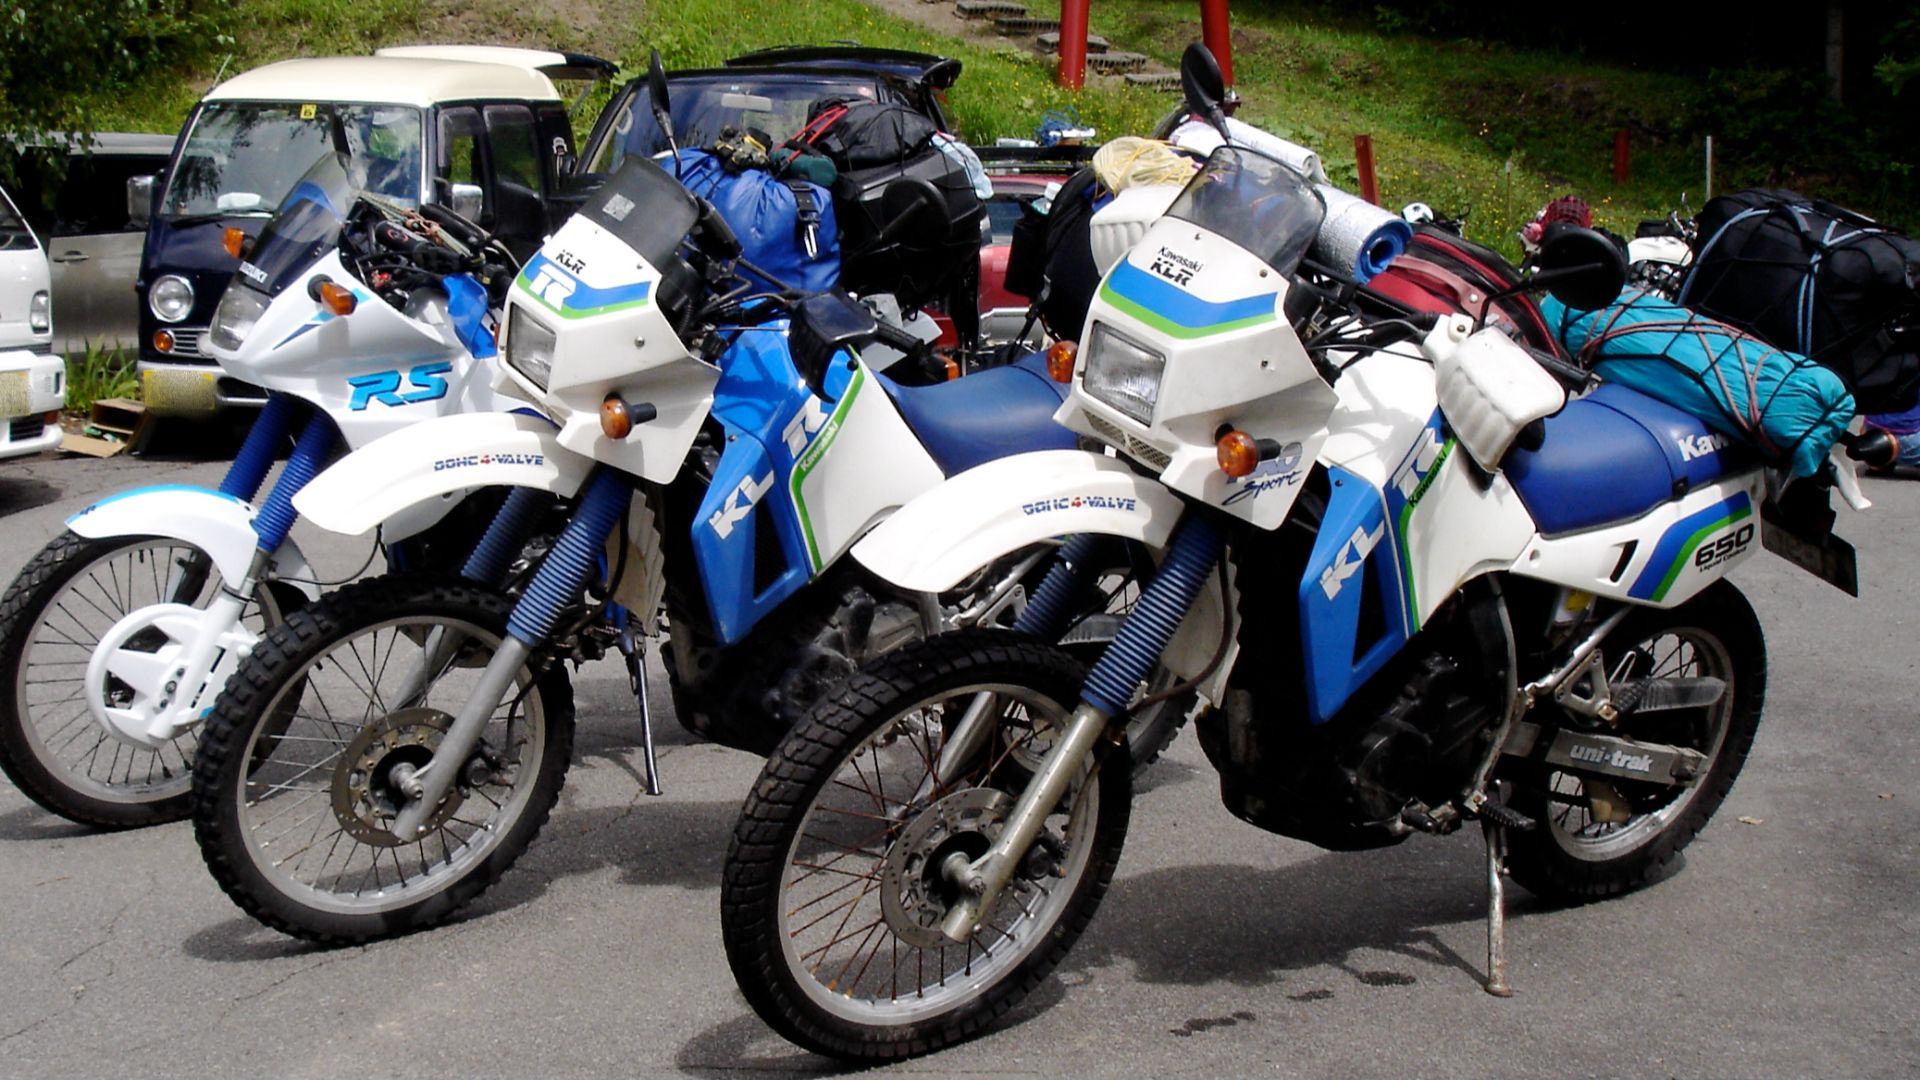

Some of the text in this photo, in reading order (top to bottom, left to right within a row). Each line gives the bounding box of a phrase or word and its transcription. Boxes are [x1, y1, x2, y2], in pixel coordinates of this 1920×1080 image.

[1150, 257, 1194, 287] KLR
[1158, 246, 1204, 273] Kawasaki
[347, 361, 454, 411] RS
[800, 420, 839, 472] Kawasaki
[433, 455, 479, 472] DOHC
[1407, 451, 1448, 508] Kawasaki
[1221, 470, 1303, 506] Sport
[1022, 497, 1070, 515] DOHC
[1695, 523, 1755, 567] 650
[1570, 744, 1654, 773] uni-trak
